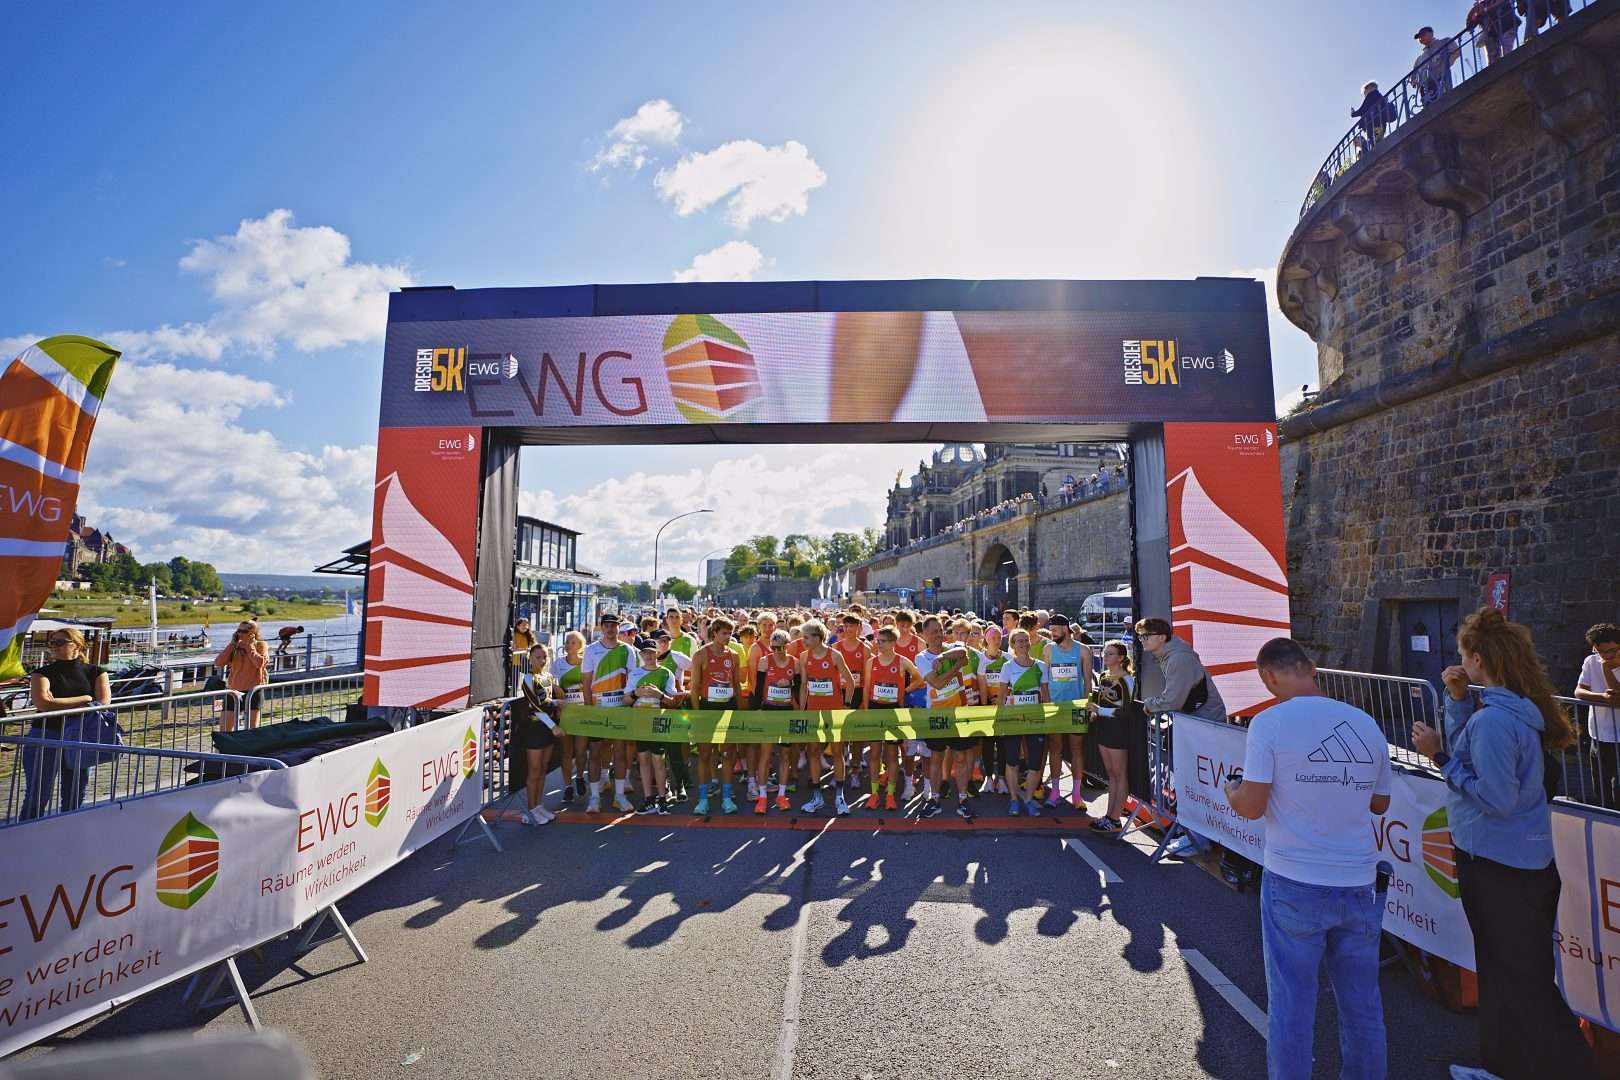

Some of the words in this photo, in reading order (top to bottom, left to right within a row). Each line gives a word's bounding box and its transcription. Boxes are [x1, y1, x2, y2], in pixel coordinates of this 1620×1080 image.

[414, 348, 433, 392] DRESDEN
[431, 348, 465, 391] 5K
[466, 350, 648, 418] EWG
[468, 362, 499, 376] EWG
[1123, 340, 1142, 385] DRESDEN
[1141, 340, 1178, 385] 5K
[1182, 356, 1215, 370] EWG
[439, 439, 462, 449] EWG
[1234, 434, 1259, 444] EWG
[422, 750, 459, 792] EWG
[1185, 785, 1211, 808] Räume
[297, 792, 359, 853] EWG
[1205, 812, 1262, 849] Wirklichkeit
[261, 864, 313, 896] Räume
[316, 841, 357, 870] werden
[304, 855, 367, 901] Wirklichkeit
[26, 933, 134, 985] werden
